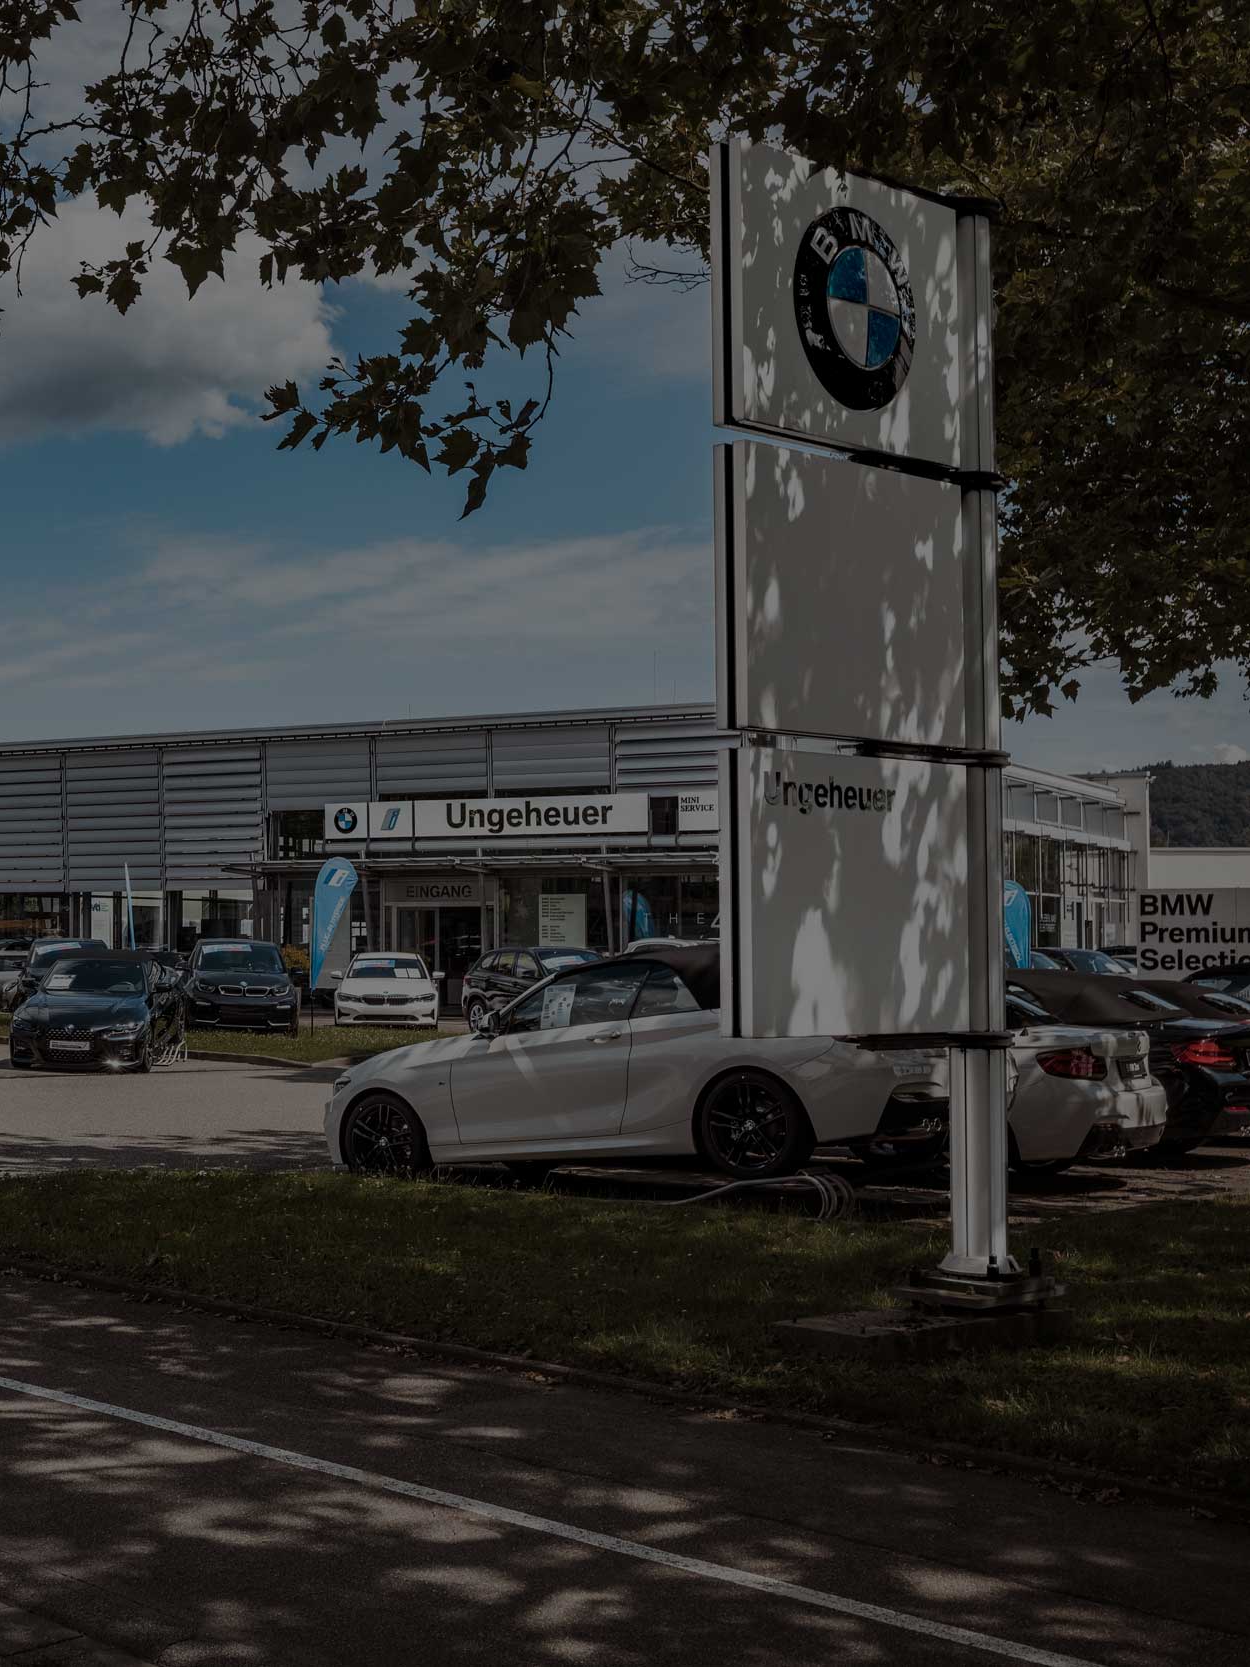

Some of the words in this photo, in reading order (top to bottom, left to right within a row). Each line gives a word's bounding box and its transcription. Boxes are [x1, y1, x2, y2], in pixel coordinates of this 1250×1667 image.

[764, 771, 896, 814] Ungeheuer
[446, 800, 613, 833] Ungeheuer
[406, 885, 472, 898] EINGANG
[1140, 893, 1214, 916] BMW
